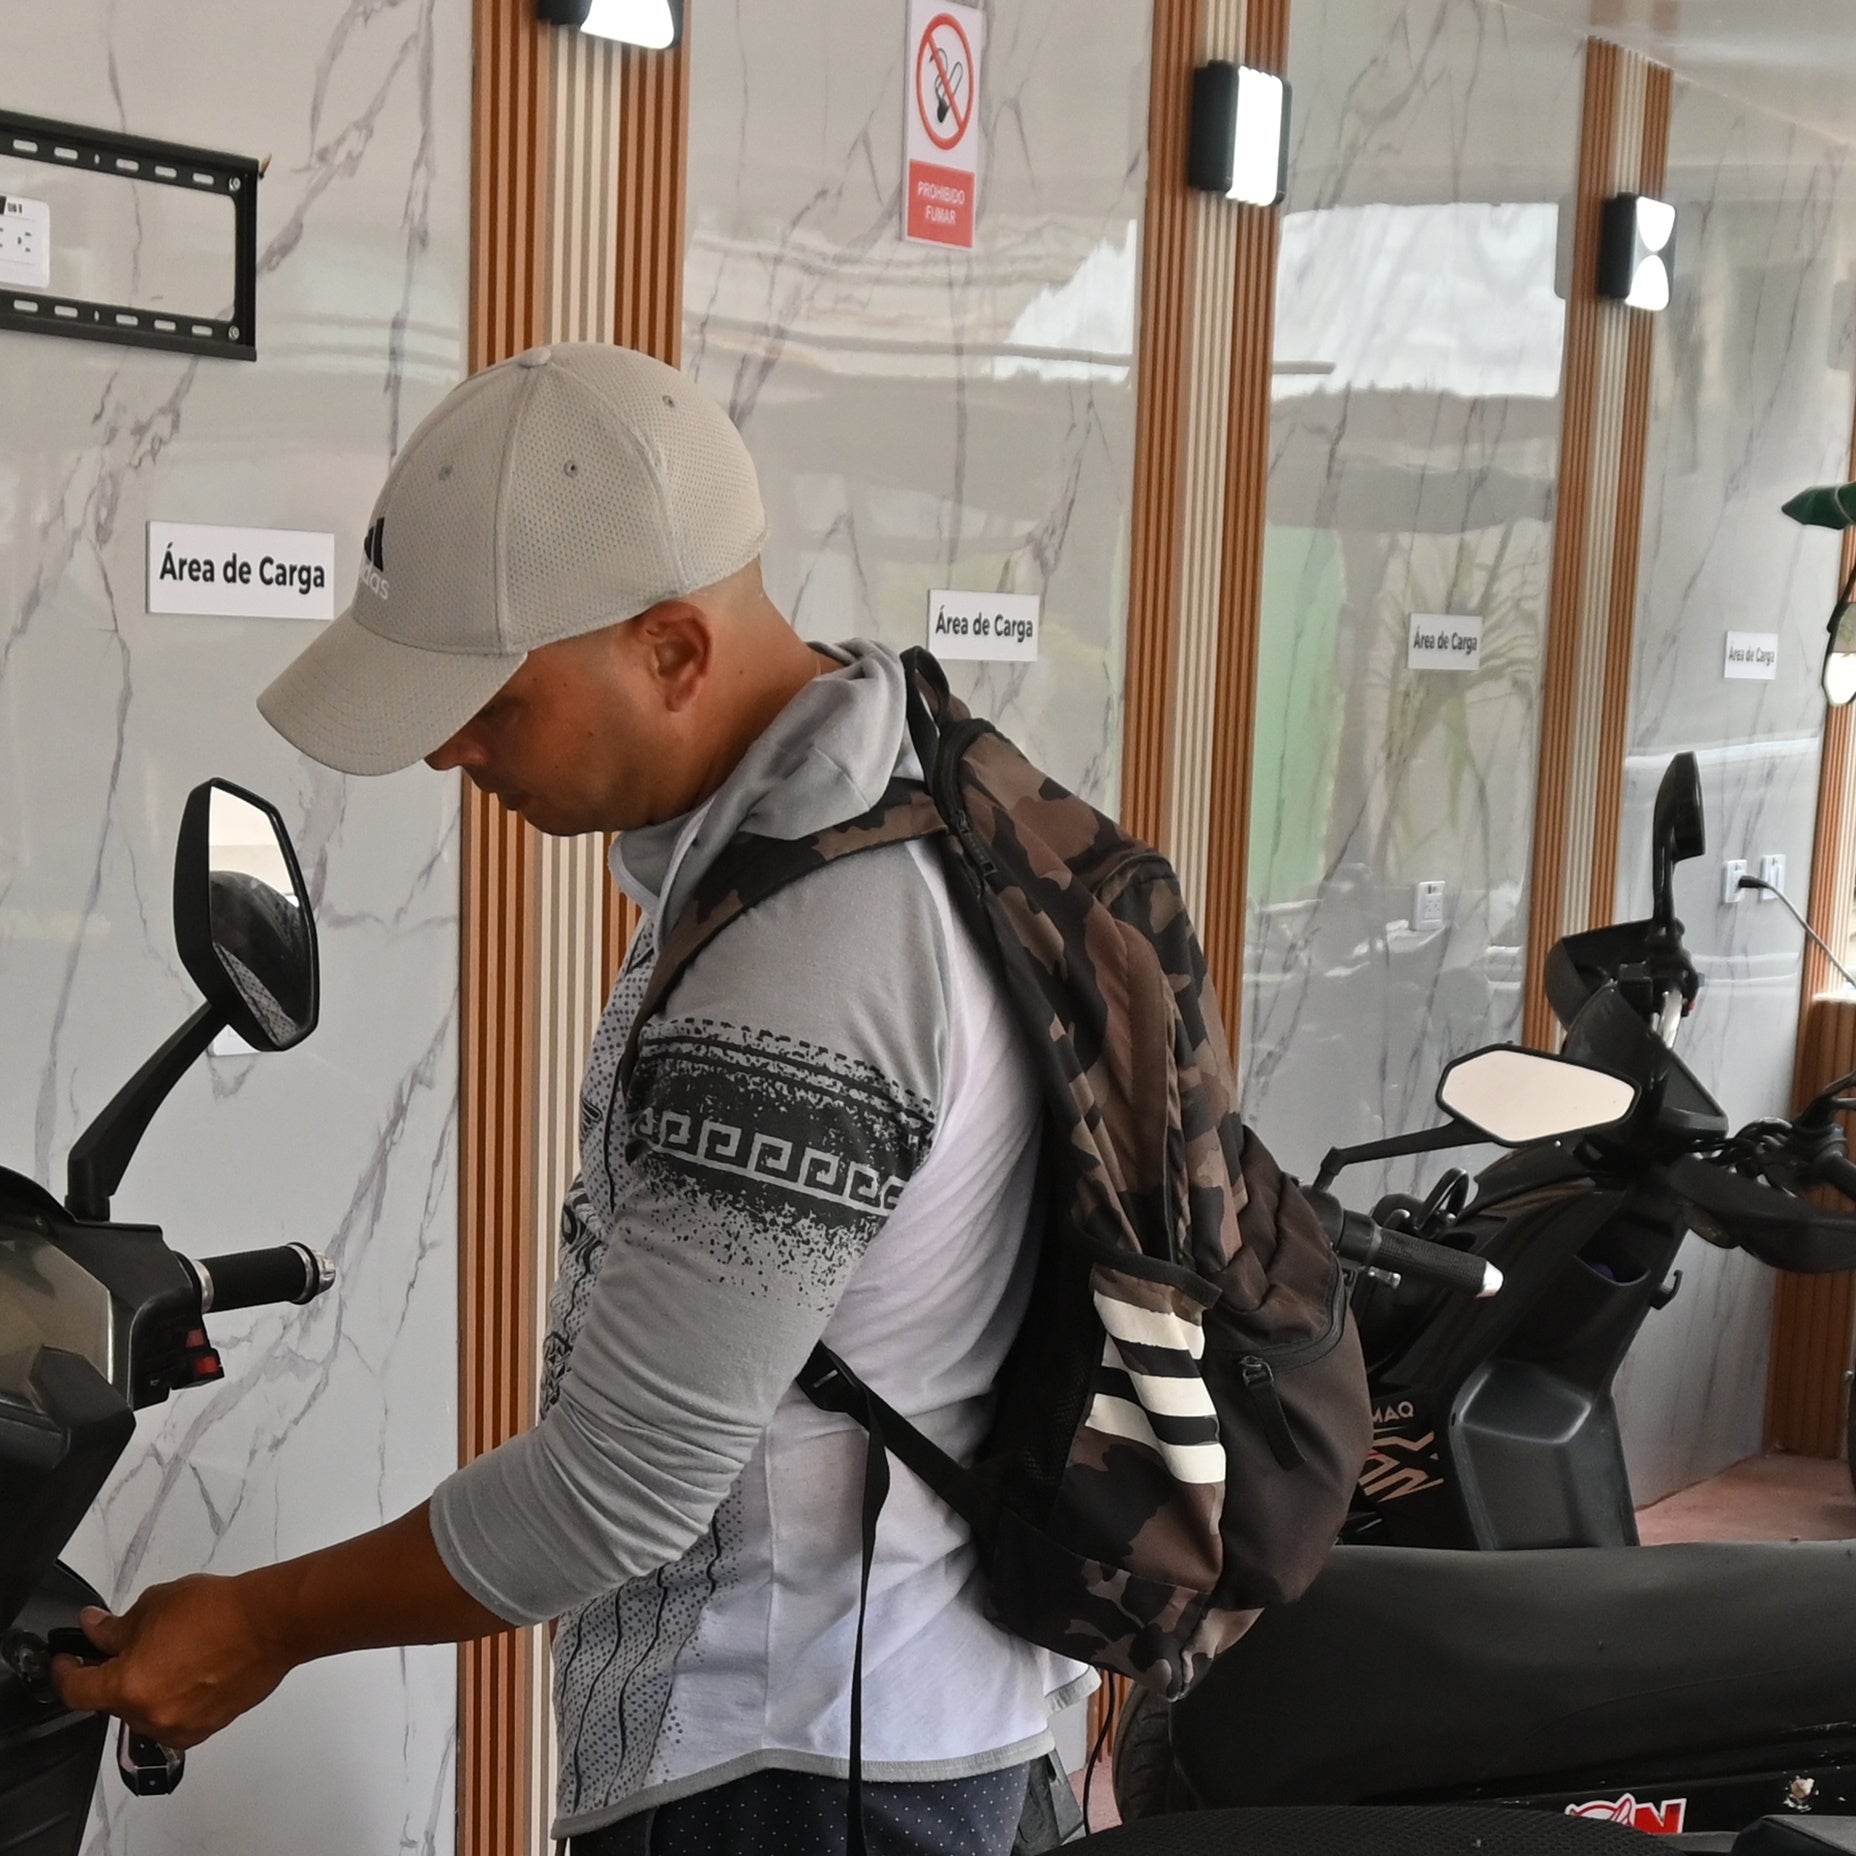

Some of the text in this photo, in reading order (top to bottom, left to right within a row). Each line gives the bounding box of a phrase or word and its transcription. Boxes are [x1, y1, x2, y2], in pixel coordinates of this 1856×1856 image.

[917, 181, 966, 205] PROHIBIDO
[925, 204, 957, 225] FUMAR
[159, 541, 325, 596] Área de Carga
[935, 604, 1033, 643] Área de Carga
[1413, 625, 1478, 655] Área de Carga
